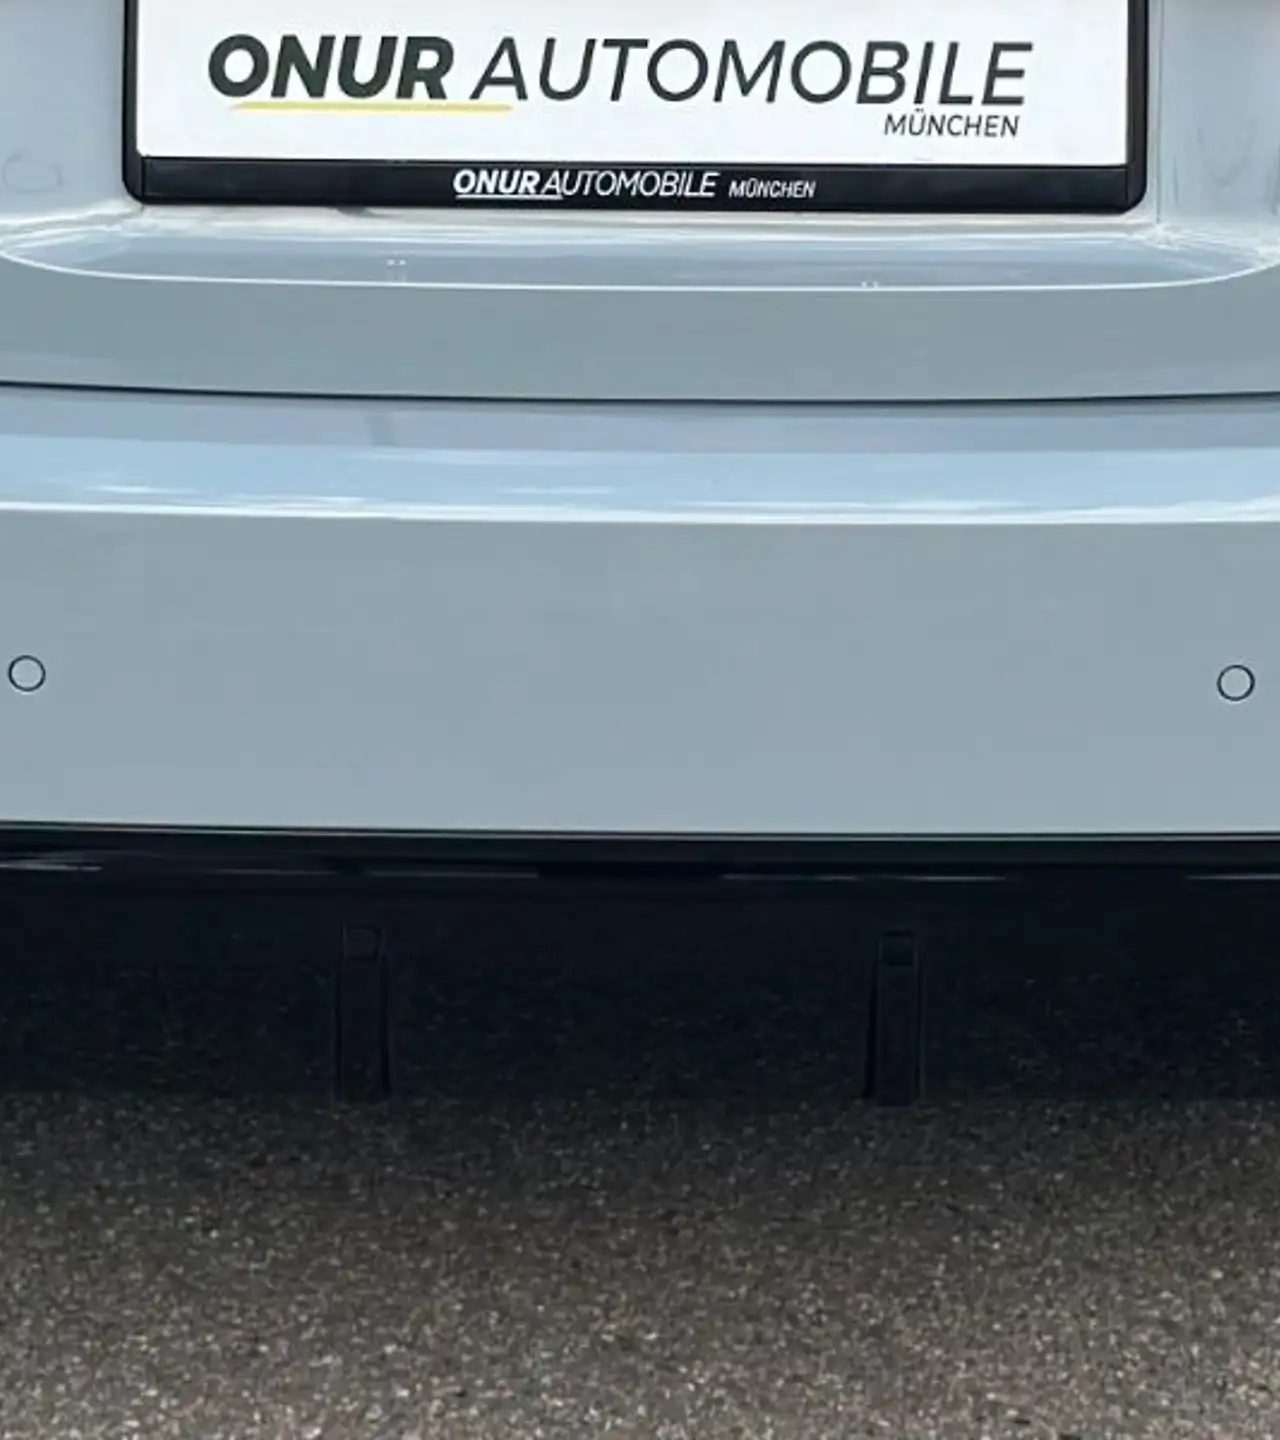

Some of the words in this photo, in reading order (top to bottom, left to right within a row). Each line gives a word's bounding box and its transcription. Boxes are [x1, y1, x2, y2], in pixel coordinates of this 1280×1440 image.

[208, 33, 455, 100] ONUR
[469, 36, 1033, 106] AUTOMOBILE
[883, 108, 1020, 139] MÜNCHEN
[727, 177, 817, 200] MÜNCHEN
